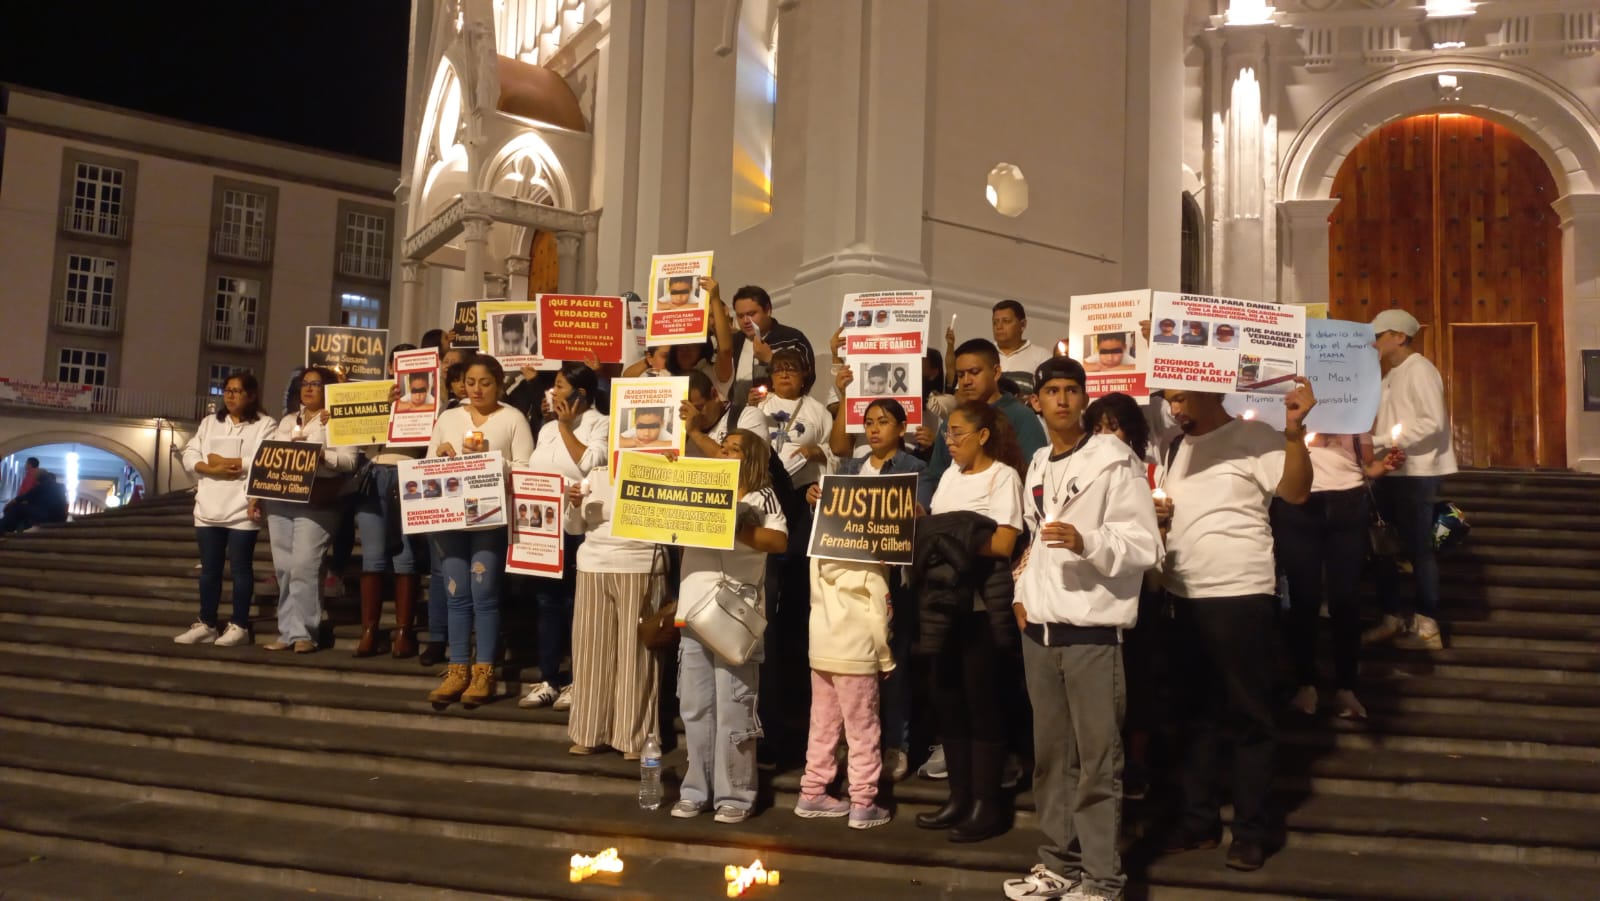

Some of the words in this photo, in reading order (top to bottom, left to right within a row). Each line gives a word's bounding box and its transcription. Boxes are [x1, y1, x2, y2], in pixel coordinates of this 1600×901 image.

[554, 310, 607, 318] VERDADERO
[311, 334, 383, 355] JUSTICIA
[853, 341, 878, 350] MADRE
[880, 340, 888, 349] DE
[890, 339, 916, 349] DANIEL!
[1249, 333, 1297, 343] VERDADERO
[342, 355, 368, 364] Susana
[1155, 358, 1200, 367] EXIGIMOS
[352, 365, 381, 374] Gilberto
[1201, 376, 1232, 384] MAX!!!
[334, 408, 343, 416] DE
[344, 407, 353, 415] LA
[379, 404, 389, 413] DE
[255, 448, 316, 471] JUSTICIA
[267, 470, 279, 479] Ana
[281, 472, 303, 482] Susana
[630, 464, 672, 480] EXIGIMOS
[673, 470, 685, 483] LA
[686, 469, 731, 486] DETENCIÓN
[253, 480, 281, 491] Fernanda
[282, 485, 287, 494] y
[288, 483, 309, 494] Gilberto
[627, 484, 640, 496] DE
[642, 486, 654, 498] LA
[657, 488, 688, 502] MAMÁ
[691, 491, 703, 503] DE
[705, 493, 728, 505] MAX.
[823, 486, 913, 518] JUSTICIA
[623, 504, 655, 517] PARTE
[657, 507, 726, 523] FUNDAMENTAL
[621, 515, 642, 526] PARA
[695, 522, 705, 532] EL
[844, 520, 864, 533] Ana
[867, 521, 899, 534] Susana
[820, 533, 868, 550] Fernanda
[871, 540, 878, 553] y
[880, 537, 911, 551] Gilberto
